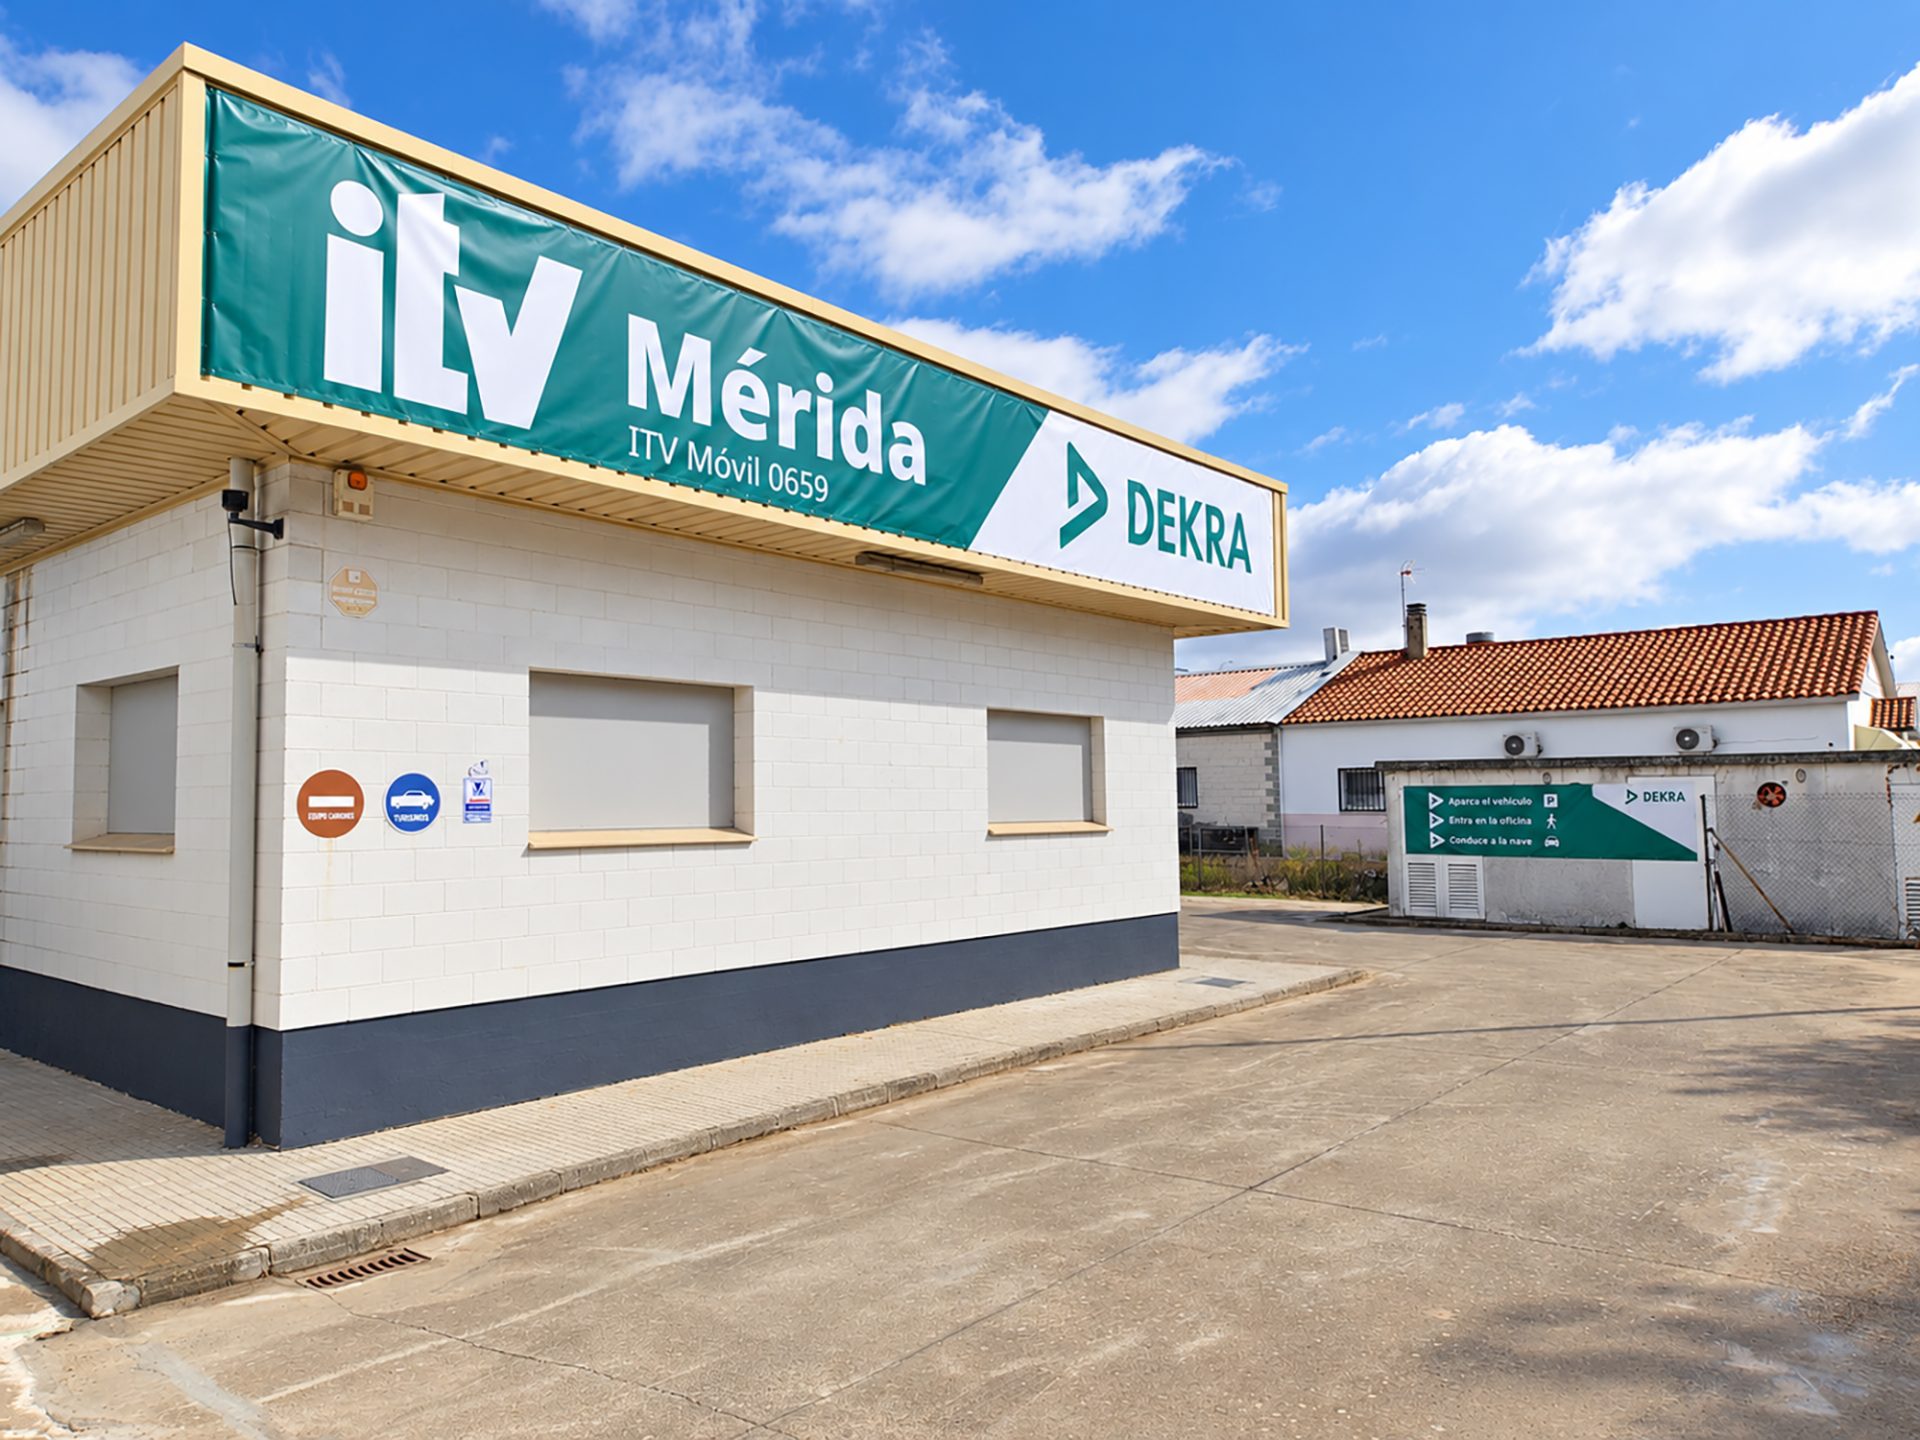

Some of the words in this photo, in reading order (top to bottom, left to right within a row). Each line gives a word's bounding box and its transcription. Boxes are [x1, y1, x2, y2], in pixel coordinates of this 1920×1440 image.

[324, 180, 583, 430] itv
[628, 313, 926, 486] Mérida
[628, 425, 679, 465] ITV
[687, 440, 760, 487] Móvil
[768, 463, 829, 502] 0659
[1127, 479, 1252, 573] DEKRA
[1448, 797, 1480, 807] Aparca
[1481, 797, 1490, 805] el
[1643, 791, 1686, 802] DEKRA
[1449, 836, 1488, 845] Conduce
[1498, 837, 1508, 845] la
[1509, 838, 1533, 846] nave
[1488, 816, 1498, 825] la
[1499, 816, 1532, 825] oficina
